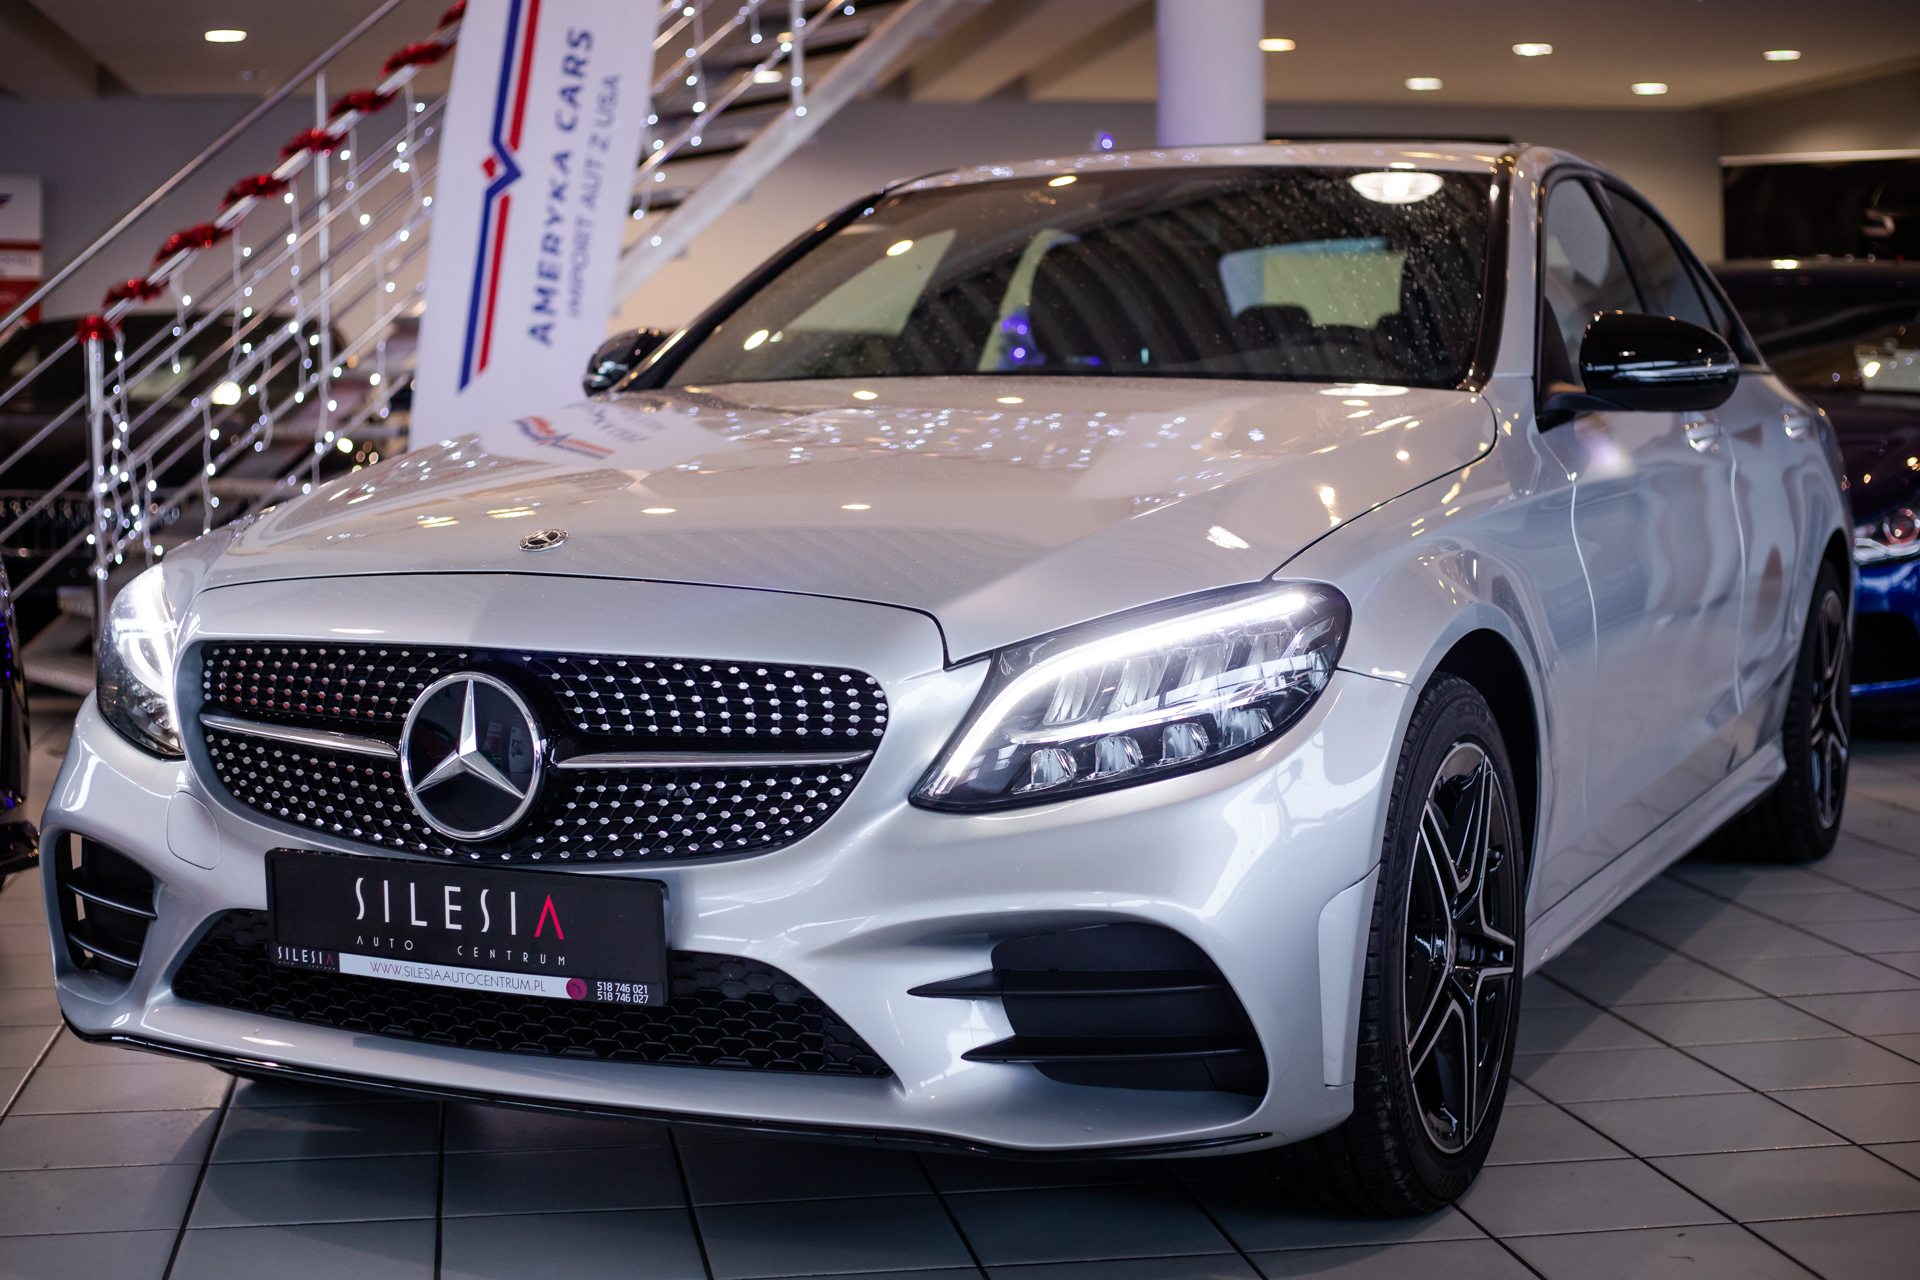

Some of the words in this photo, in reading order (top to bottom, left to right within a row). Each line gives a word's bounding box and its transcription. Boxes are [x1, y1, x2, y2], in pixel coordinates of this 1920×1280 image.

[592, 74, 623, 130] USA
[527, 150, 573, 348] AMERYKA
[554, 26, 595, 133] CARS
[579, 155, 605, 211] AUT
[567, 212, 595, 319] IMPORT
[355, 877, 564, 940] SILESIA
[278, 946, 334, 966] SILESIA
[356, 935, 414, 950] AUTO
[457, 945, 565, 966] CENTRUM
[370, 961, 546, 992] WWW.SILESIAAUTOCENTRUM.PL
[597, 981, 613, 992] 518
[615, 983, 631, 993] 746
[633, 984, 648, 994] 021
[597, 992, 613, 1001] 518
[615, 993, 631, 1003] 746
[633, 994, 649, 1004] 027
